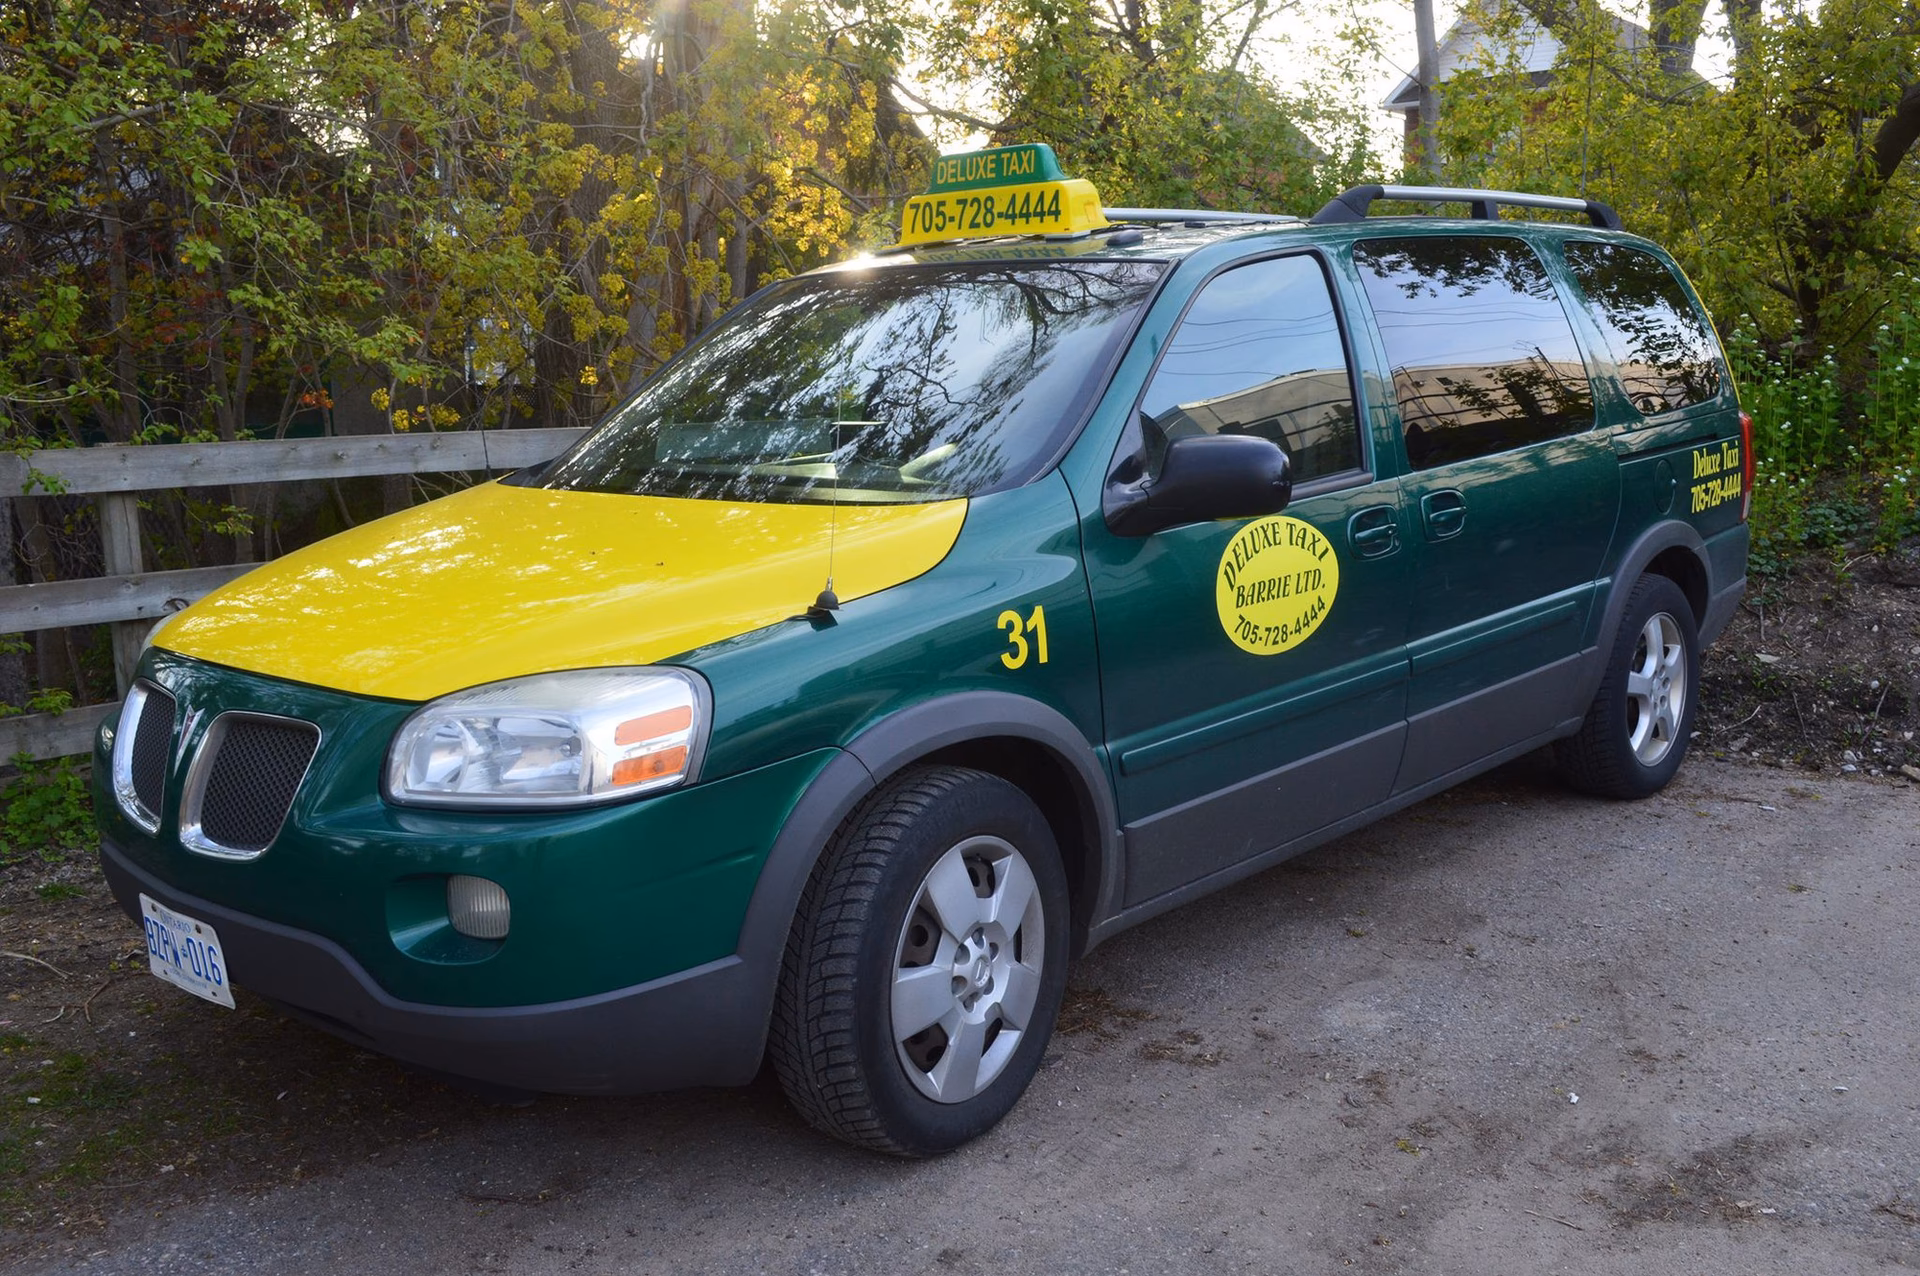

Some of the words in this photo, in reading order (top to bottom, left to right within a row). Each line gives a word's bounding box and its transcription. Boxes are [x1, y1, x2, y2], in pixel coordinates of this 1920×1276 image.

[936, 154, 996, 184] DELUXE
[1001, 149, 1035, 176] TAXI
[909, 189, 1061, 234] 705-728-4444
[1693, 447, 1720, 479] Deluxe
[1721, 440, 1739, 470] Taxi
[1691, 472, 1741, 514] 705-728-4444
[1223, 522, 1282, 592] DELUXE
[1286, 522, 1330, 562] TAXI
[1236, 574, 1292, 609] BARRIE
[1295, 568, 1326, 595] LTD.
[997, 605, 1048, 670] 31
[1234, 595, 1326, 647] 705-728-4444
